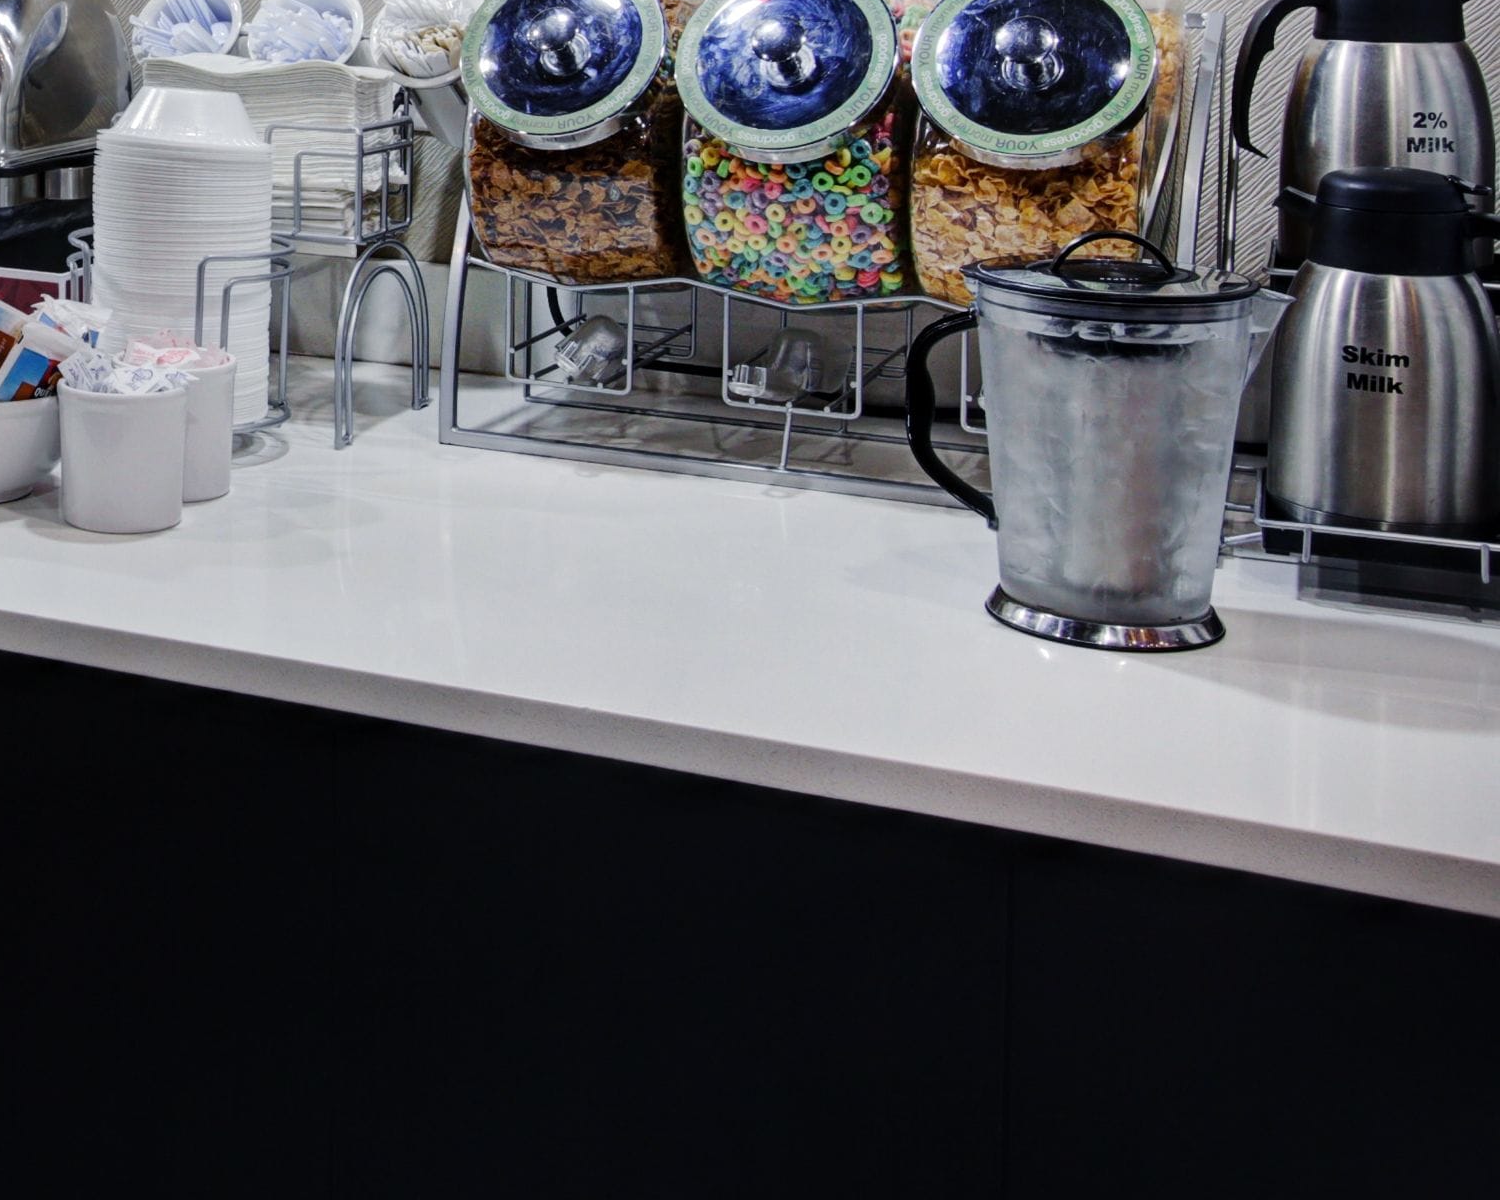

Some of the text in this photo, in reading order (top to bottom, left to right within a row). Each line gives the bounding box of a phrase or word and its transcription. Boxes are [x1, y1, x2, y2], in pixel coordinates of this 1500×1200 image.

[643, 2, 659, 36] YOUR
[871, 33, 889, 83] goodness
[918, 35, 933, 67] YOUR
[464, 55, 477, 87] YOUR
[473, 86, 512, 120] goodness
[595, 74, 640, 115] goodness
[846, 86, 877, 117] YOUR
[1043, 46, 1150, 148] YOUR morning goodness
[557, 114, 595, 130] YOUR
[702, 112, 735, 138] YOUR
[920, 70, 1038, 151] YOUR morning goodness
[1412, 111, 1448, 129] 2%
[738, 129, 795, 144] goodness
[1406, 137, 1455, 153] Milk
[1341, 345, 1410, 368] Skim
[1346, 372, 1405, 395] Milk
